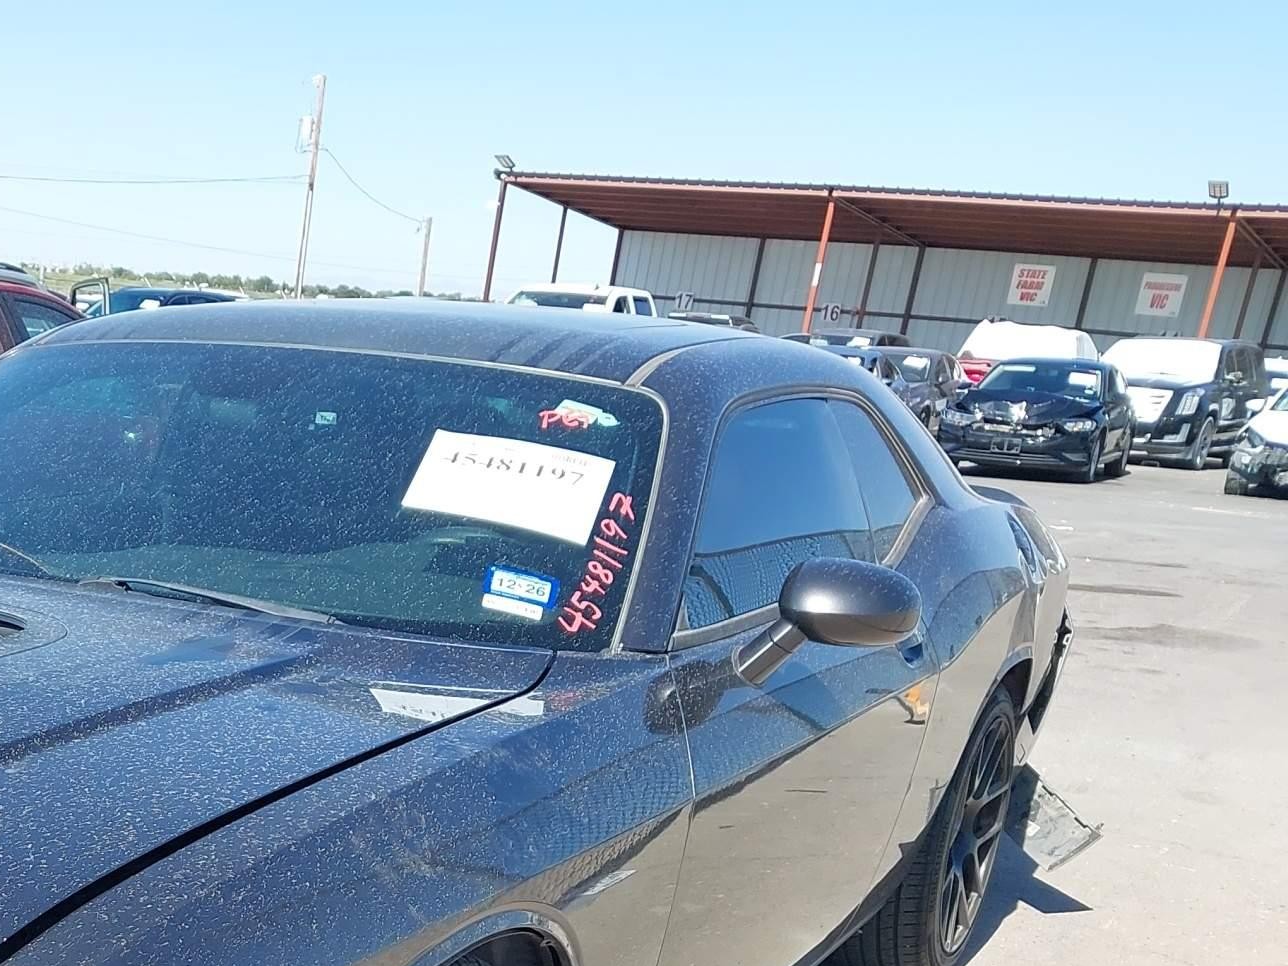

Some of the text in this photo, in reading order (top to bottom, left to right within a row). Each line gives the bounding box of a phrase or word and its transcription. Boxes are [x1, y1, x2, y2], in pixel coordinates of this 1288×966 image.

[1016, 268, 1049, 280] STATE
[1015, 279, 1045, 291] FARM
[676, 293, 694, 309] 17
[1019, 291, 1038, 302] VIC
[1150, 293, 1169, 309] VIC
[823, 304, 840, 321] 16
[442, 452, 585, 486] 45481197
[558, 492, 635, 632] 45481197
